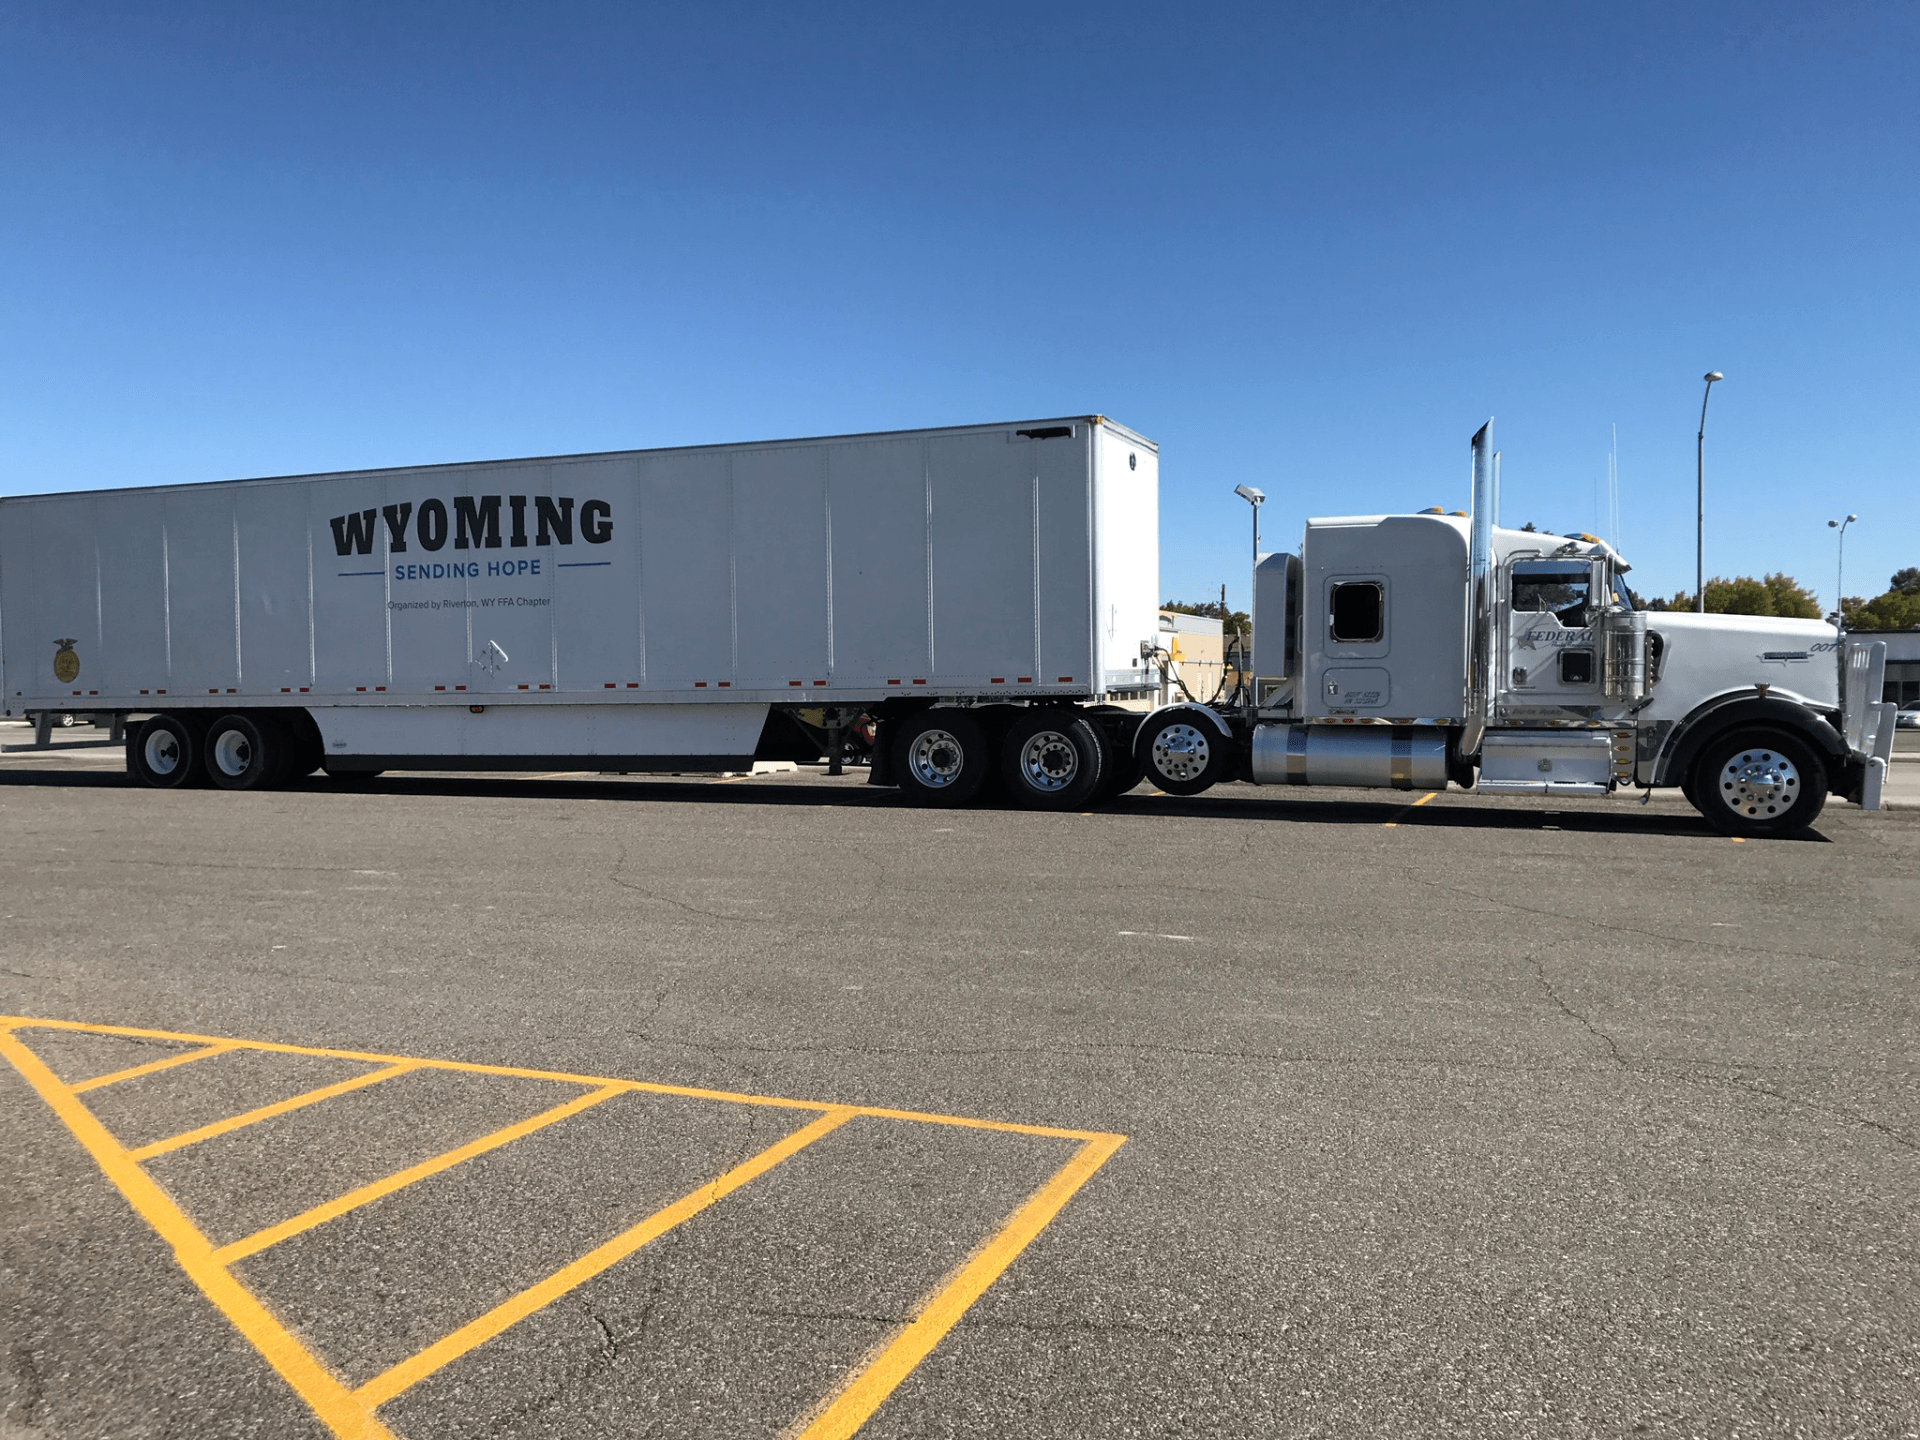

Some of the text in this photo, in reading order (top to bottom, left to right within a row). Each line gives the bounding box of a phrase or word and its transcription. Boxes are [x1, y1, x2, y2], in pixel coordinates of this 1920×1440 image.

[330, 495, 614, 556] WYOMING
[395, 559, 541, 580] SENDING HOPE
[388, 597, 550, 611] Organized by Riverton, WY FFA Chapter
